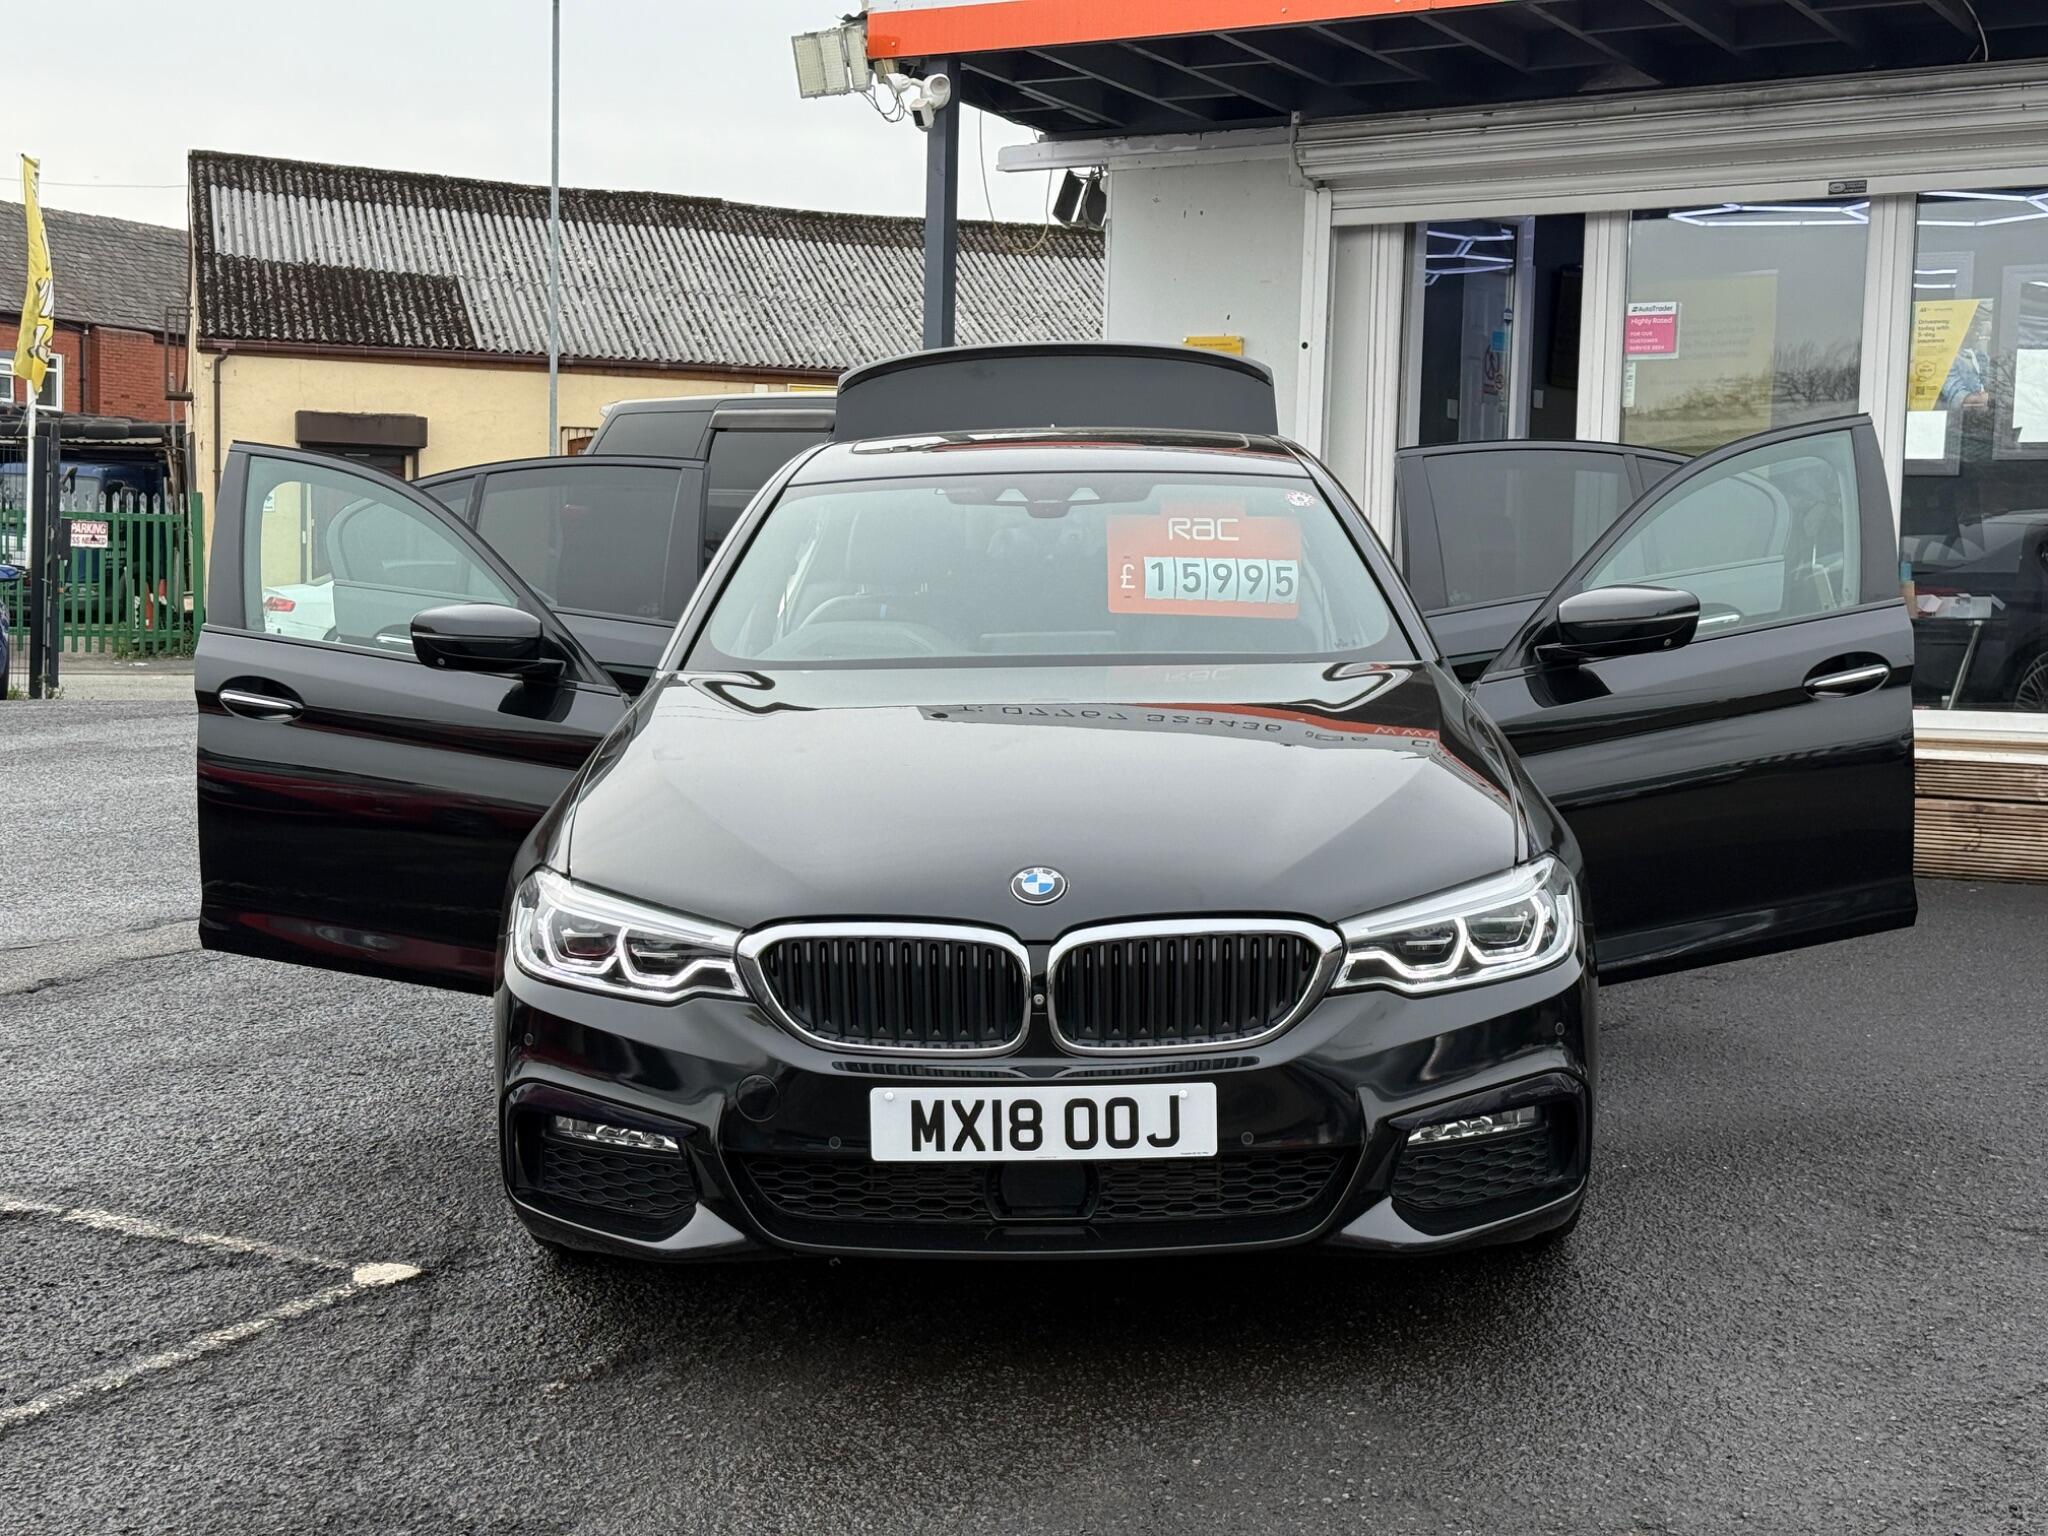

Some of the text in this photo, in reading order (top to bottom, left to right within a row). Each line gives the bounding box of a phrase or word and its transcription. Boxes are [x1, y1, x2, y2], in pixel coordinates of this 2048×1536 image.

[1630, 315, 1673, 326] Highly Rated
[72, 522, 106, 534] PARKING
[1120, 561, 1294, 598] £ 15995
[911, 1094, 1181, 1153] MX18 OOJ
